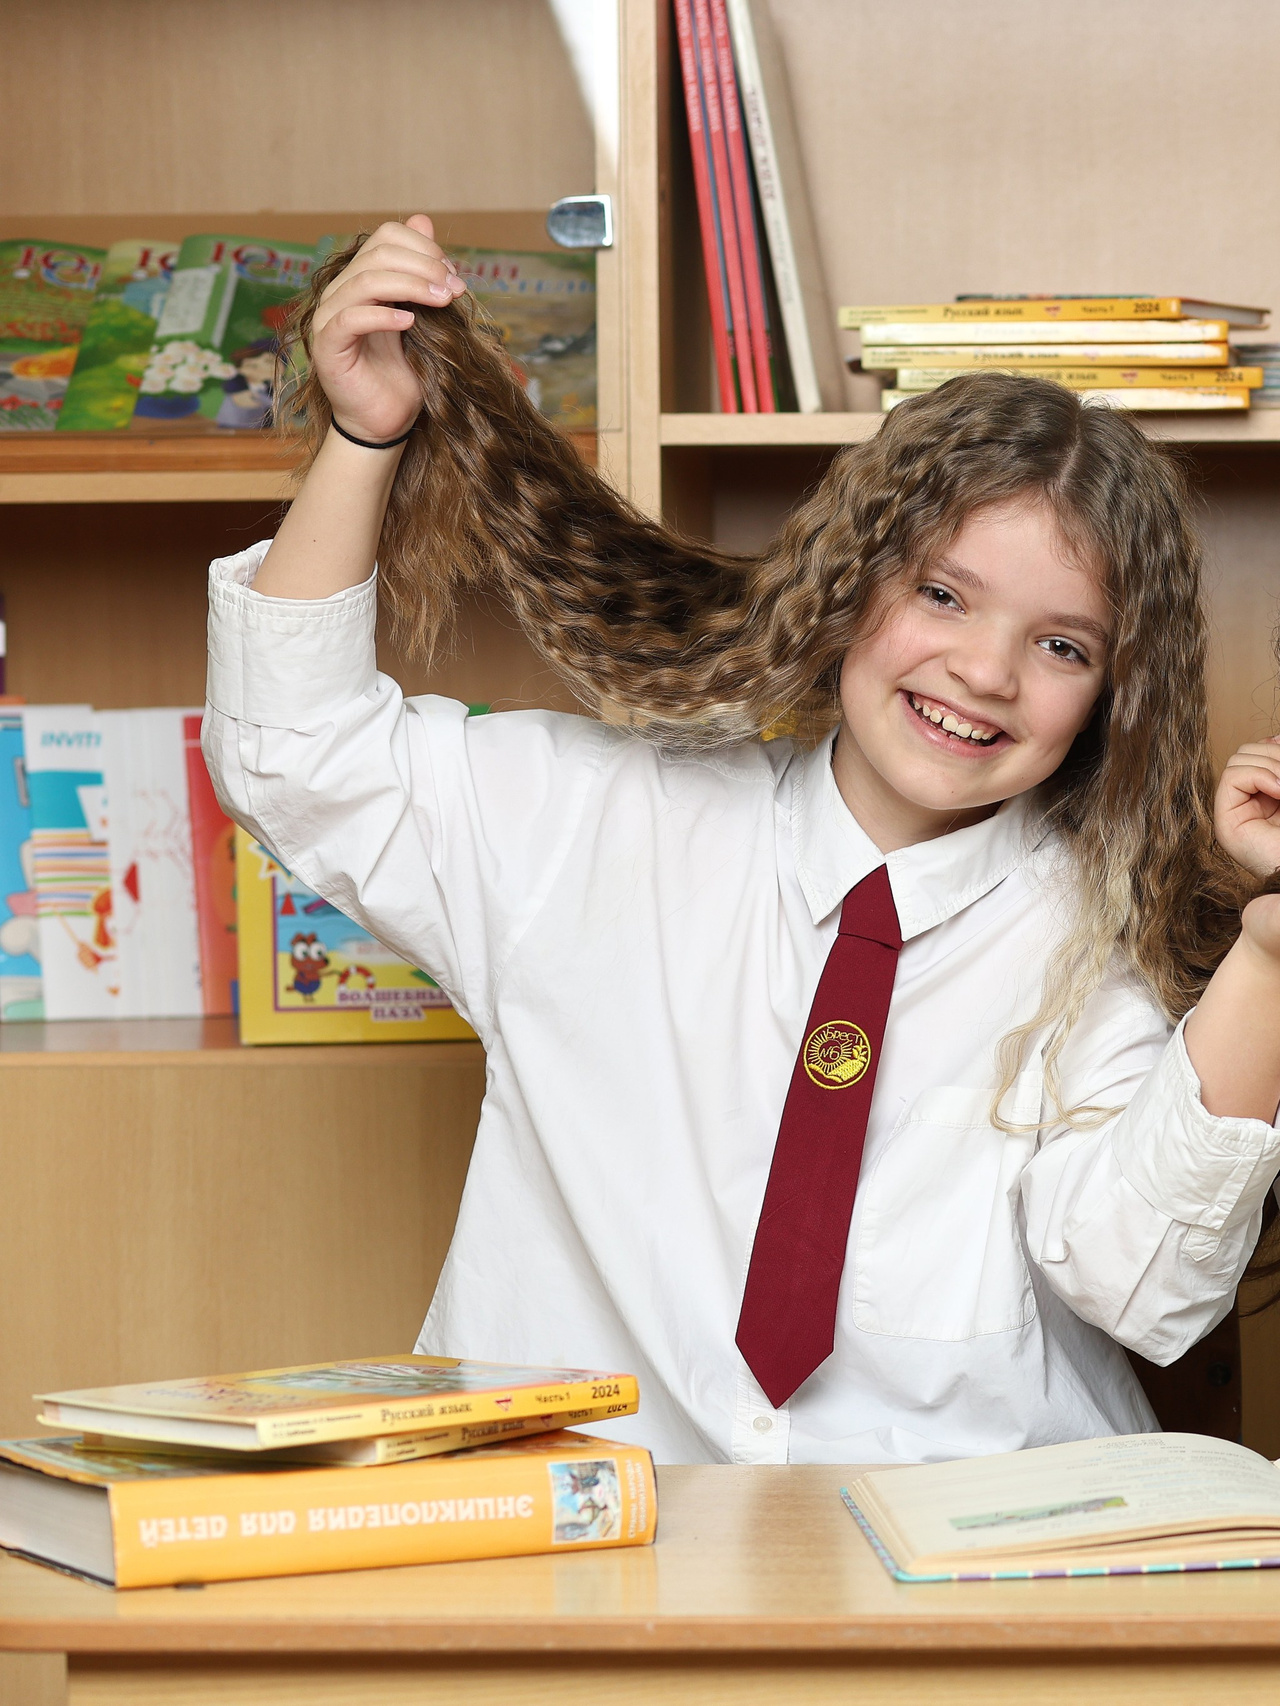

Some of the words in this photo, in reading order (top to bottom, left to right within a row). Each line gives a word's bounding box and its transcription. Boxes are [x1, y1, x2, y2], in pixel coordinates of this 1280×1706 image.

[943, 306, 990, 322] Русский
[994, 307, 1024, 317] язык
[1133, 302, 1161, 314] 2024
[1215, 370, 1244, 383] 2024
[337, 989, 450, 1003] ВОЛШЕБНЫ
[535, 1392, 565, 1405] Часть
[591, 1383, 621, 1400] 2024
[381, 1403, 435, 1426] Русский
[438, 1402, 473, 1417] язык
[460, 1421, 499, 1443] Русский
[308, 1494, 534, 1532] ЭНЦИКЛОПЕДИЯ
[138, 1513, 228, 1548] ДЕТЕЙ
[239, 1510, 296, 1538] ДЛЯ
